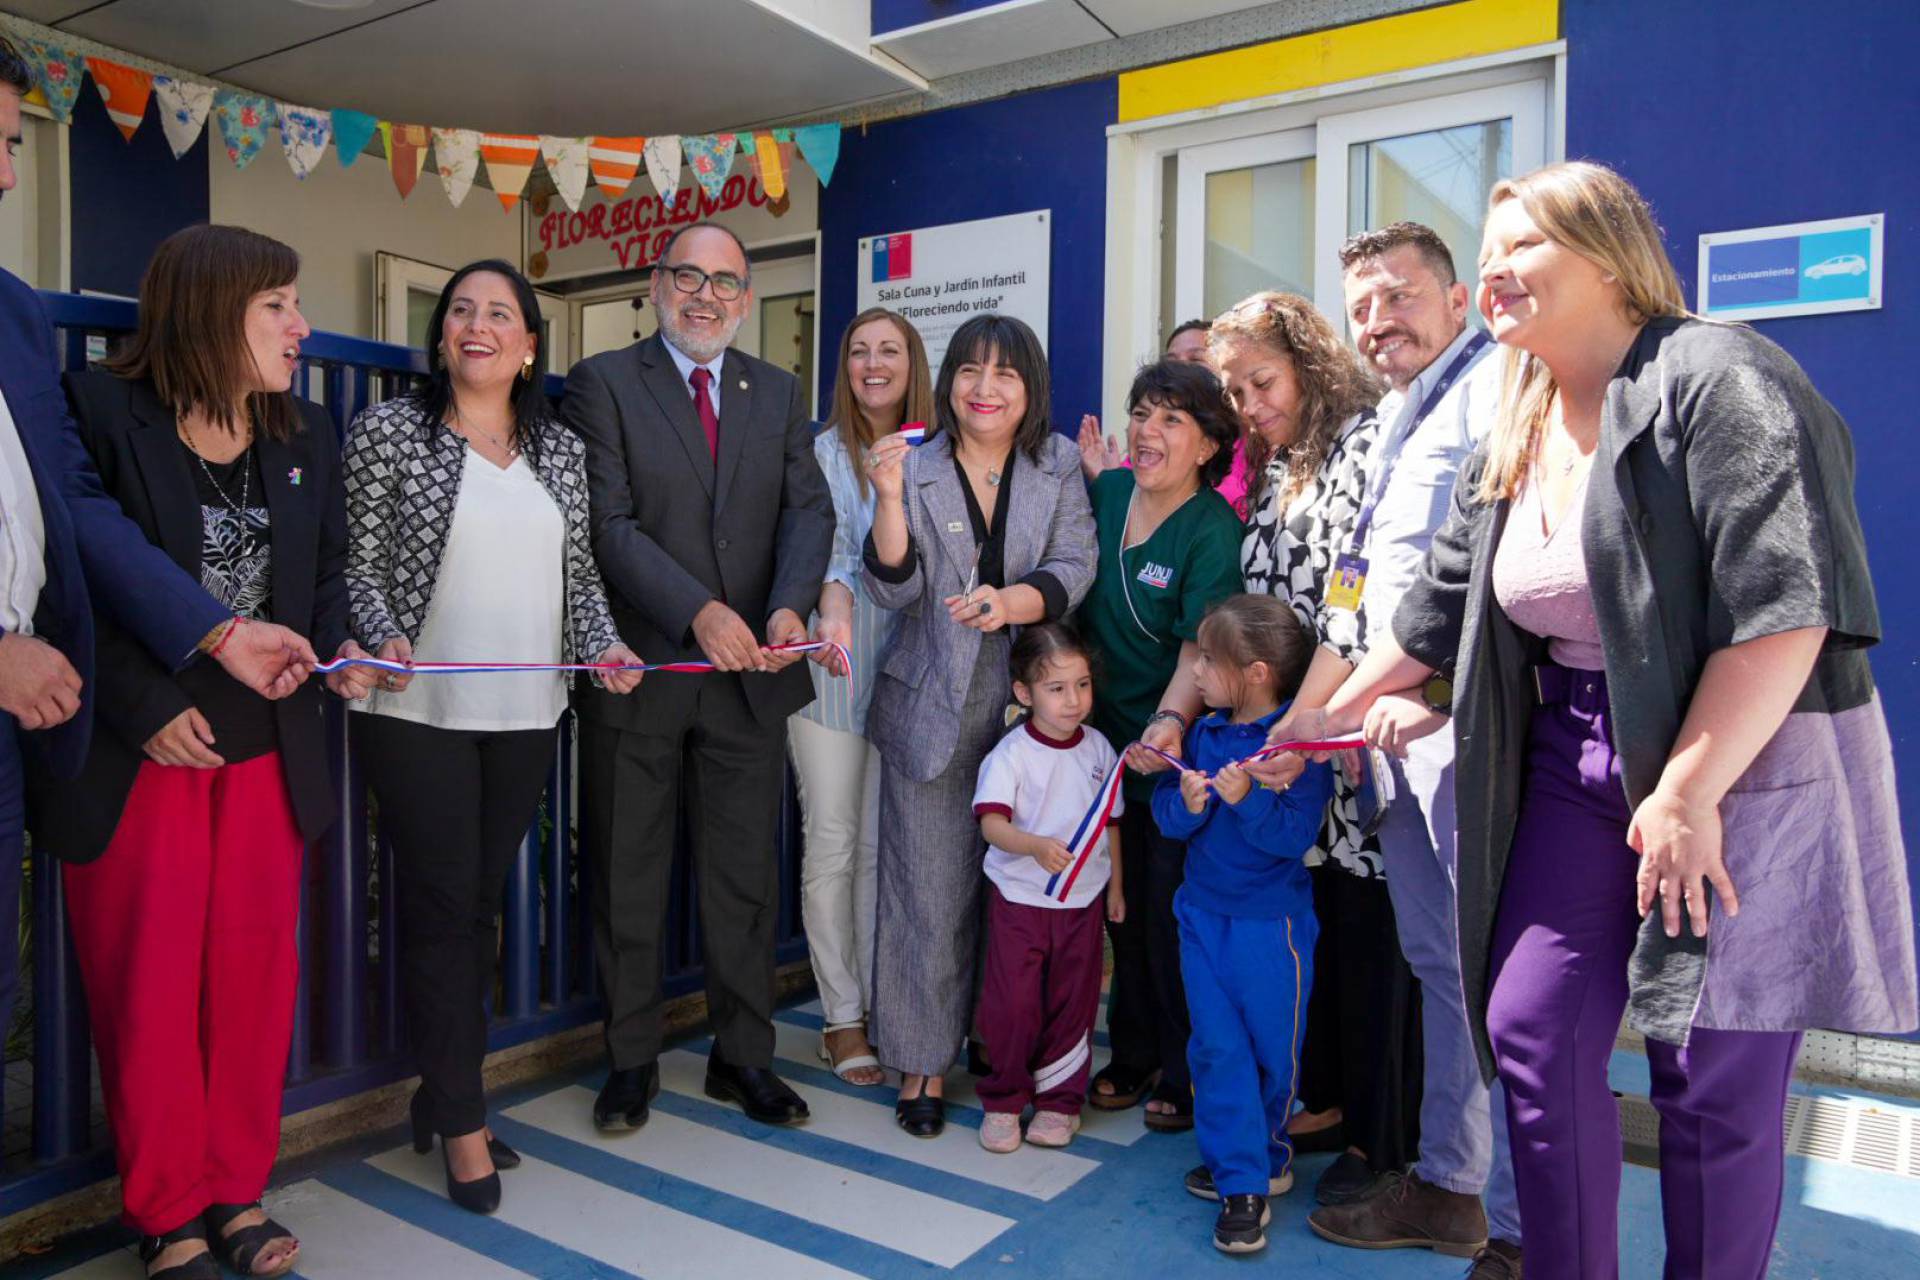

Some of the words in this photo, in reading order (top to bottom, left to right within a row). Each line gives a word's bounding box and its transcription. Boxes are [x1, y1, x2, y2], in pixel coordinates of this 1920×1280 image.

[878, 288, 901, 301] Sala
[904, 284, 931, 298] Cuna
[934, 285, 940, 297] y
[944, 278, 979, 293] Jardín
[982, 271, 1026, 289] Infantil
[1712, 267, 1795, 283] Estacionamiento
[898, 301, 970, 320] "Floreciendo
[972, 295, 1004, 311] vida"
